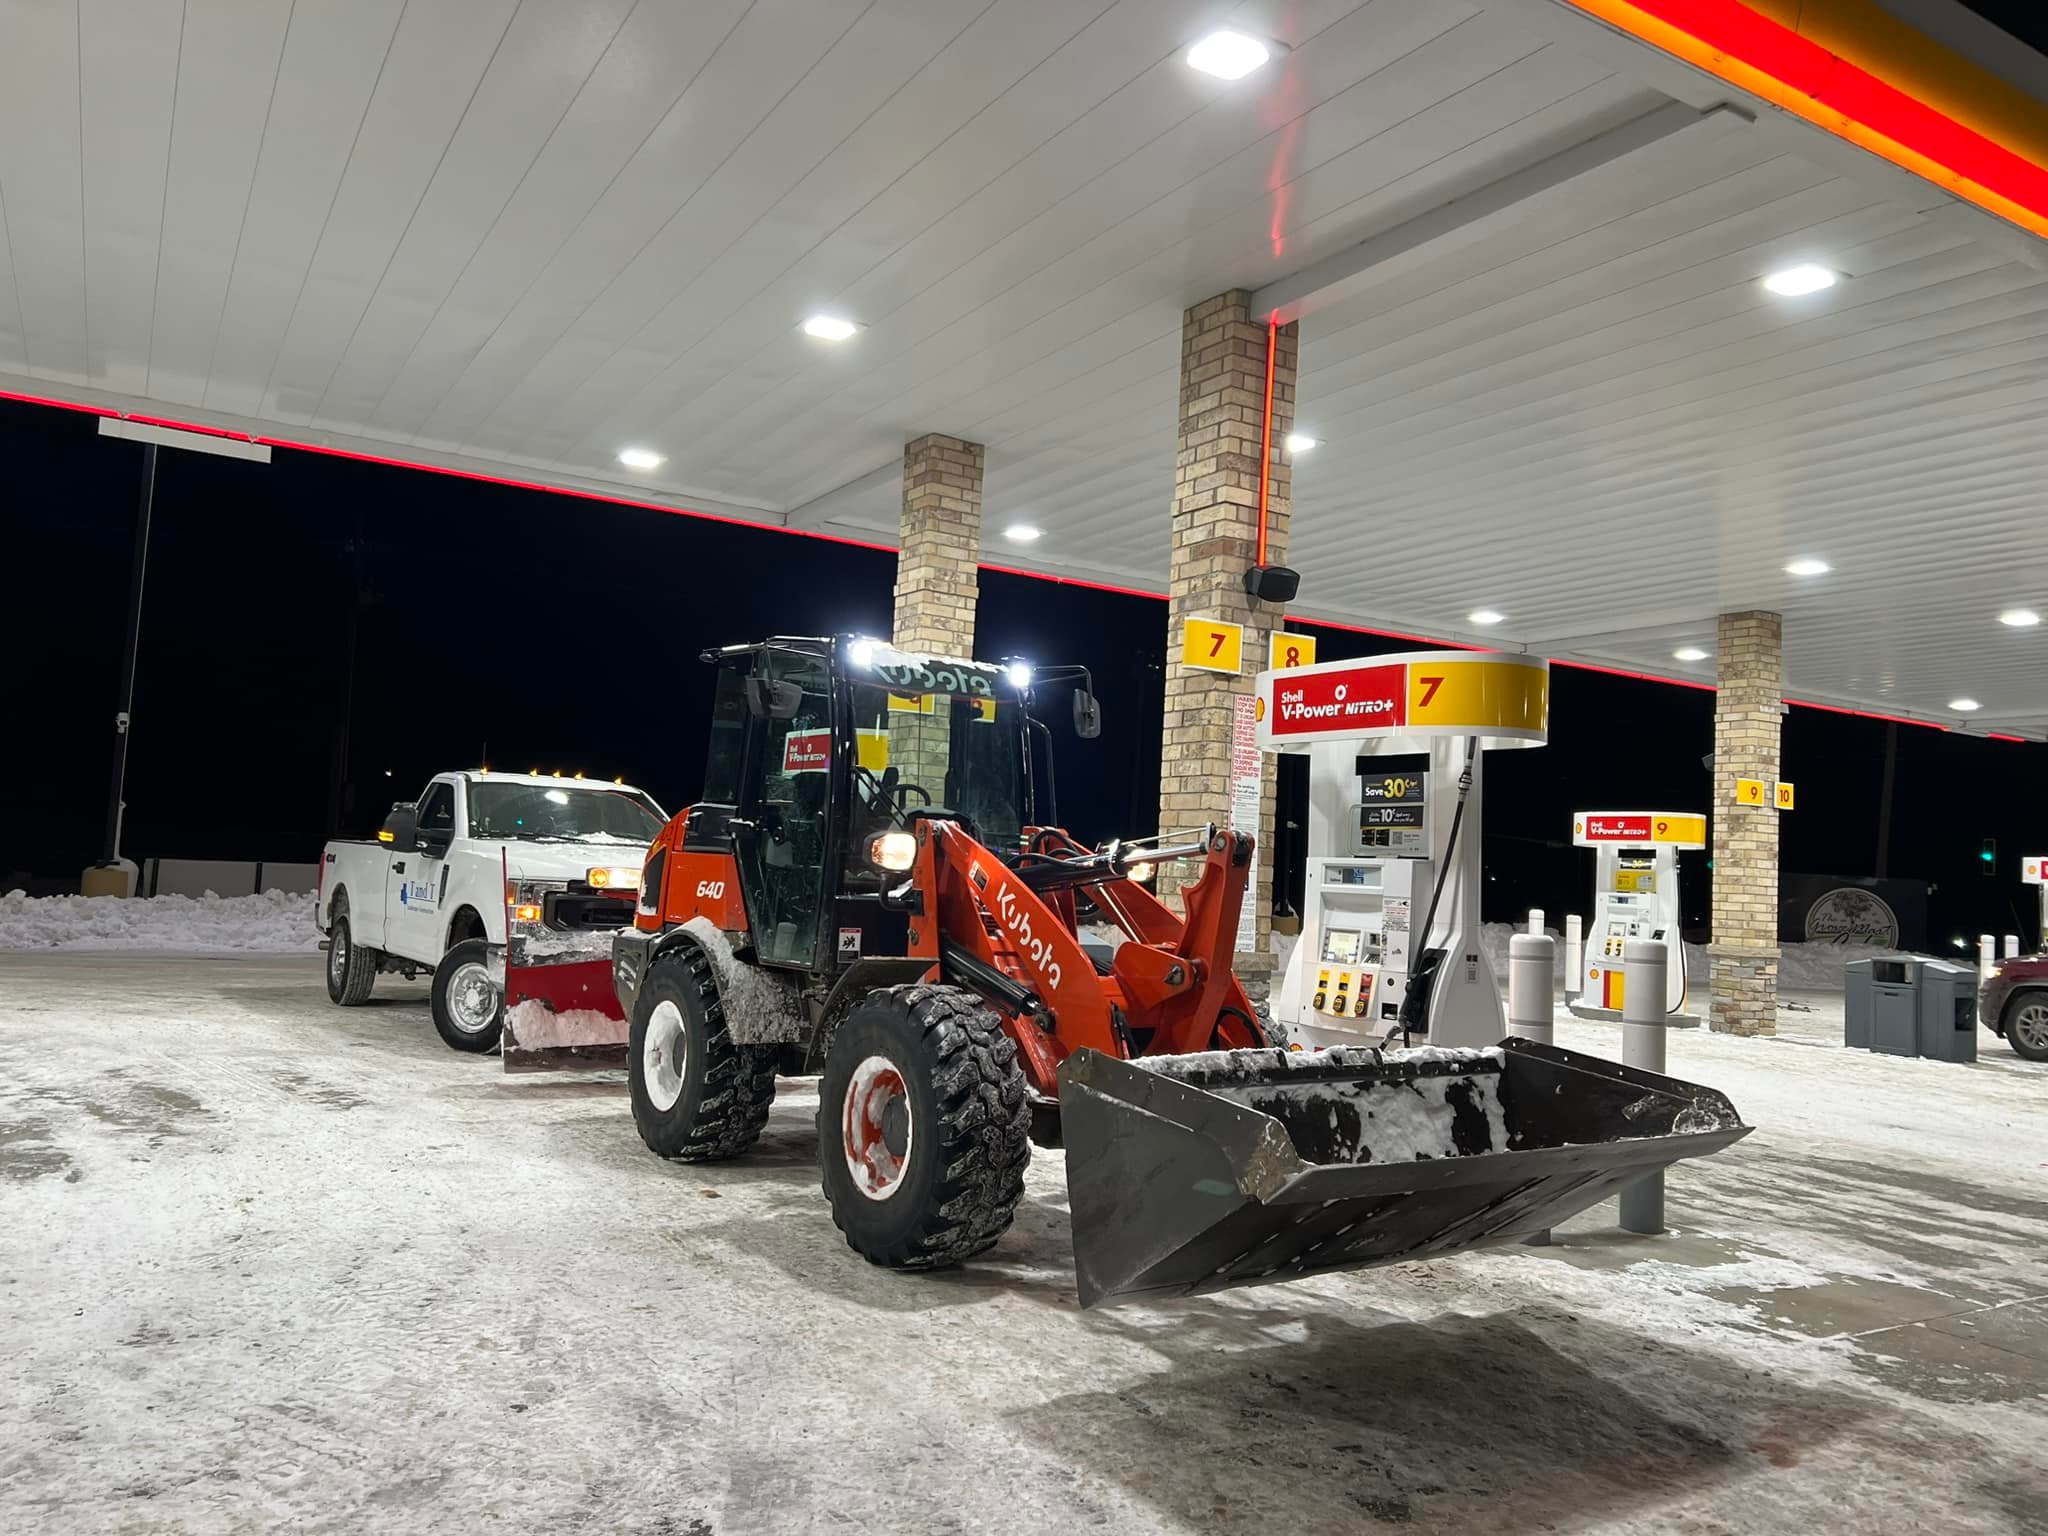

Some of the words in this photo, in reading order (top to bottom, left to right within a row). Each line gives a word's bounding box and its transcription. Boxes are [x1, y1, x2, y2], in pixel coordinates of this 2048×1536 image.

[1209, 633, 1226, 657] 7
[1286, 646, 1300, 668] 8
[1281, 690, 1303, 704] Shell
[1419, 677, 1445, 707] 7
[1281, 703, 1341, 721] V-Power
[1365, 787, 1384, 796] Save
[1751, 786, 1758, 800] 9
[1780, 789, 1790, 802] 10
[1657, 822, 1668, 834] 9
[696, 880, 725, 900] 640
[996, 881, 1061, 991] Kubota
